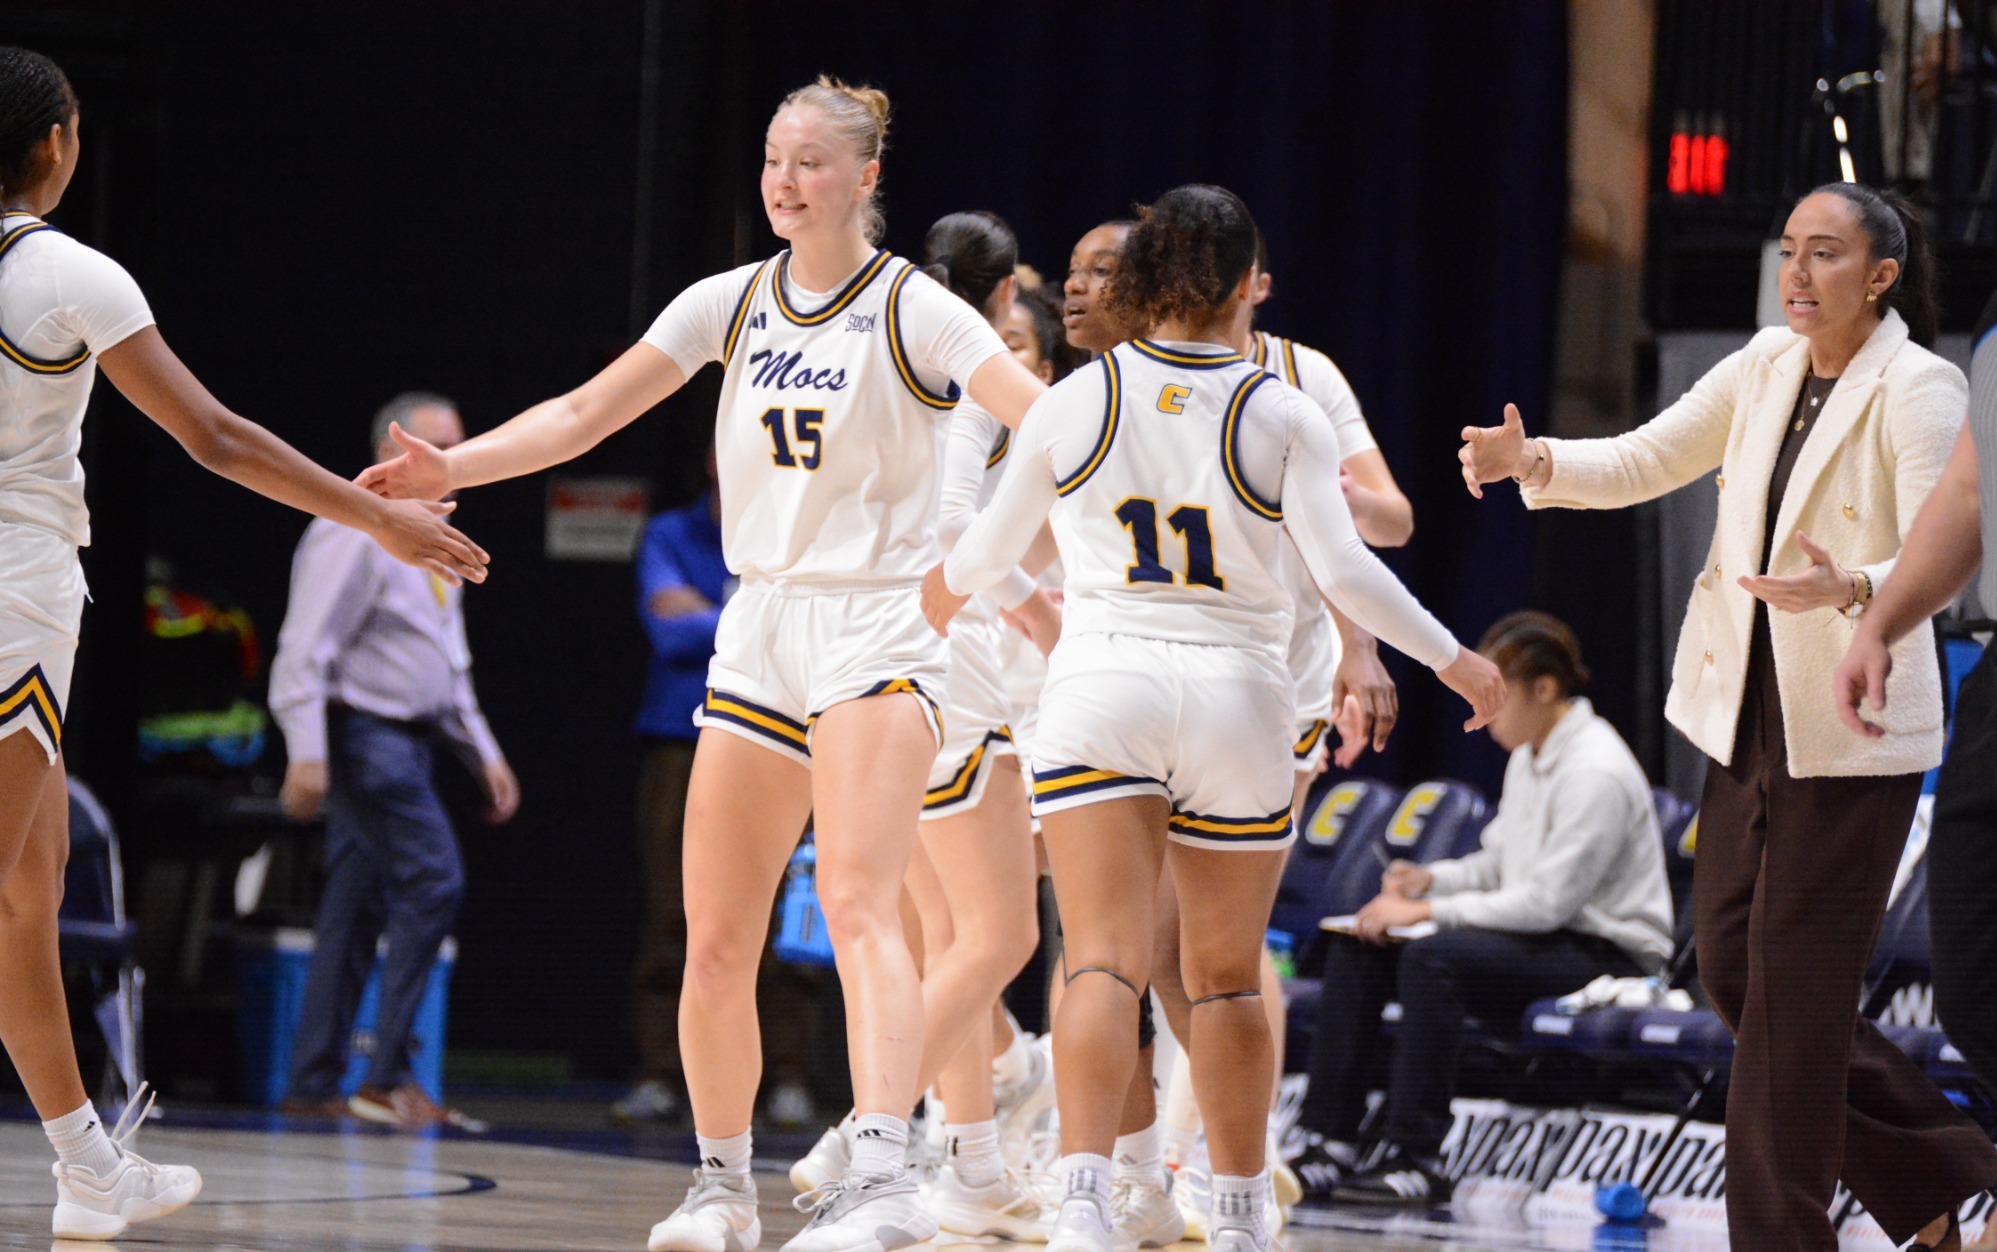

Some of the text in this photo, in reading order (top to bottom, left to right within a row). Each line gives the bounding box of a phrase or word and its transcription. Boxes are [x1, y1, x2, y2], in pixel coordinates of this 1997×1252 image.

[749, 349, 848, 391] Mocs
[1157, 383, 1193, 415] C
[759, 406, 826, 472] 15
[1112, 495, 1226, 592] 11
